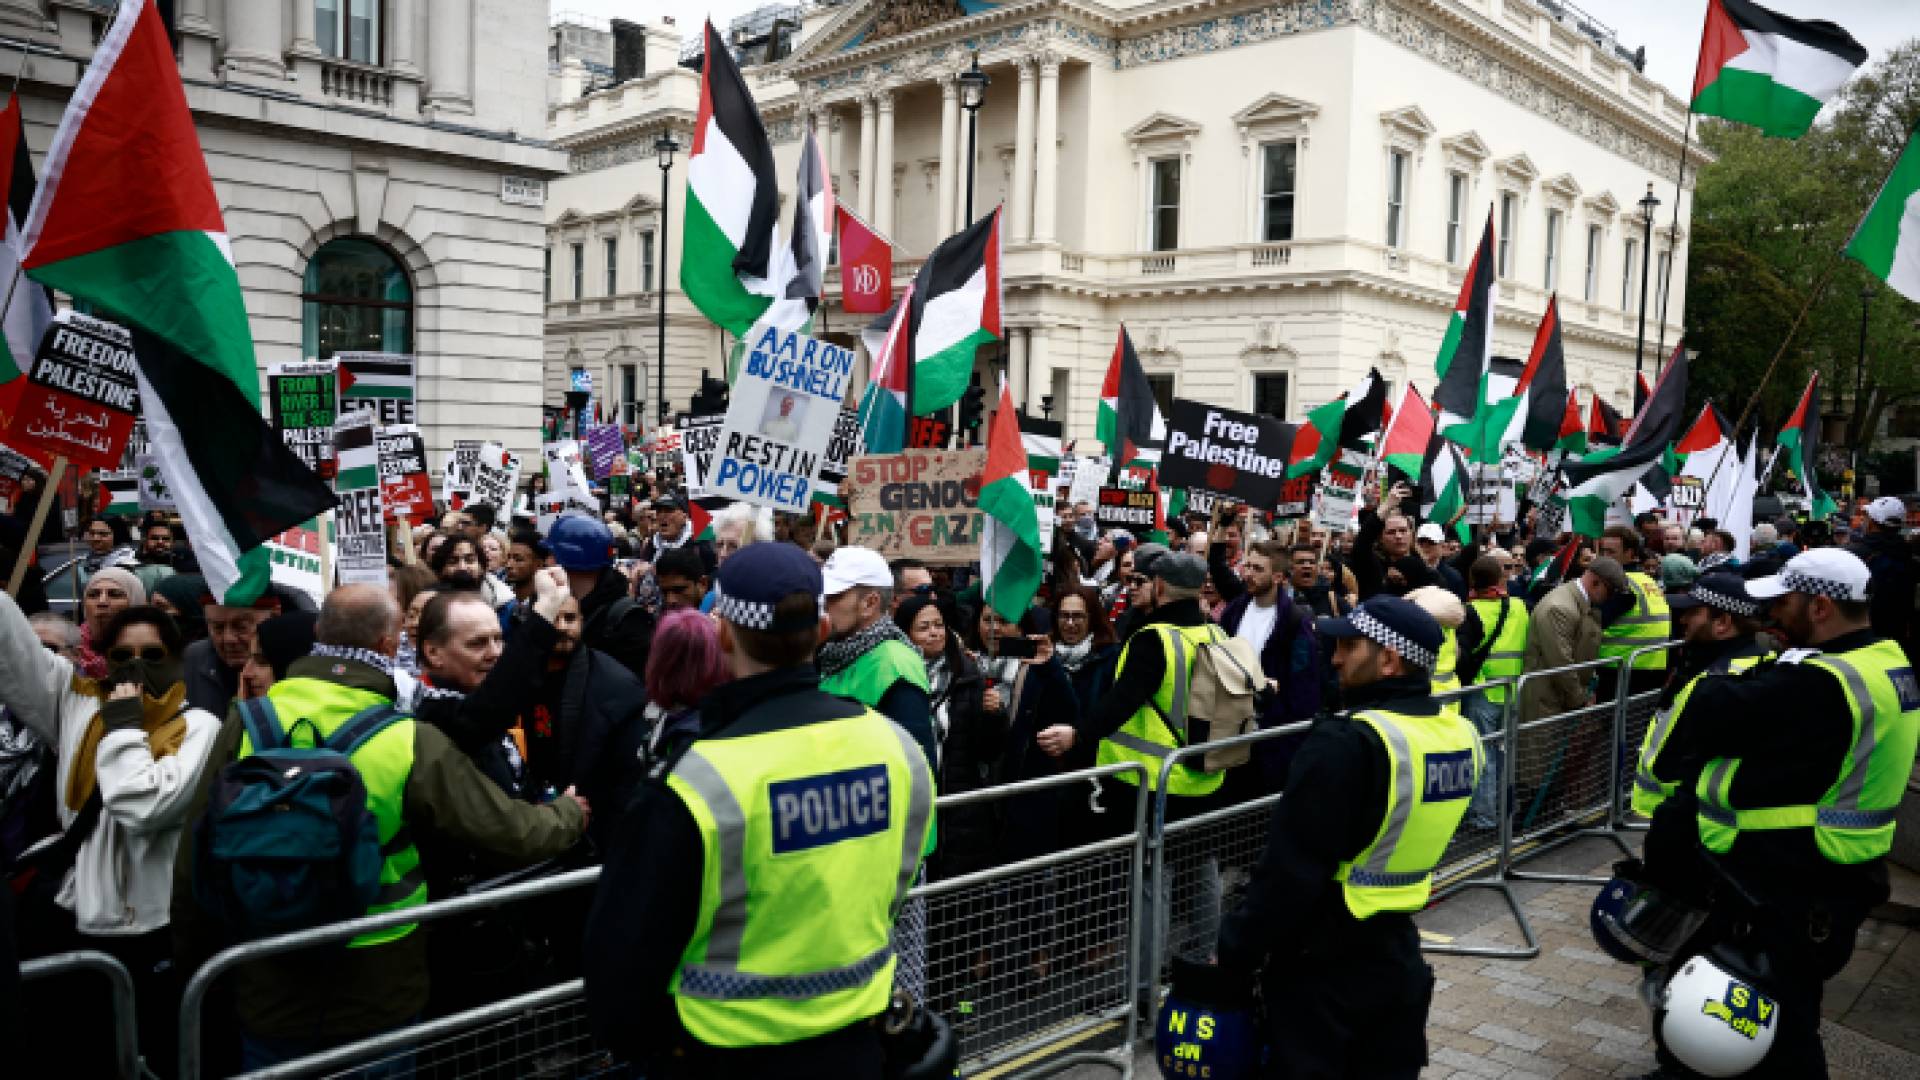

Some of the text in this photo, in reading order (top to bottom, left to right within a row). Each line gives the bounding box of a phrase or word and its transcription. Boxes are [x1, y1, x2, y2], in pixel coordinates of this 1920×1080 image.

[746, 350, 843, 401] BUSHNELL
[757, 326, 854, 376] AARON
[35, 358, 138, 411] PALESTINE
[1203, 410, 1260, 444] Free
[726, 431, 790, 469] REST
[788, 447, 817, 478] IN
[855, 454, 929, 485] STOP
[1168, 429, 1283, 479] Palestine
[715, 458, 809, 507] POWER
[857, 512, 895, 535] IN
[1425, 758, 1473, 795] POLIC
[776, 776, 888, 841] POLICE
